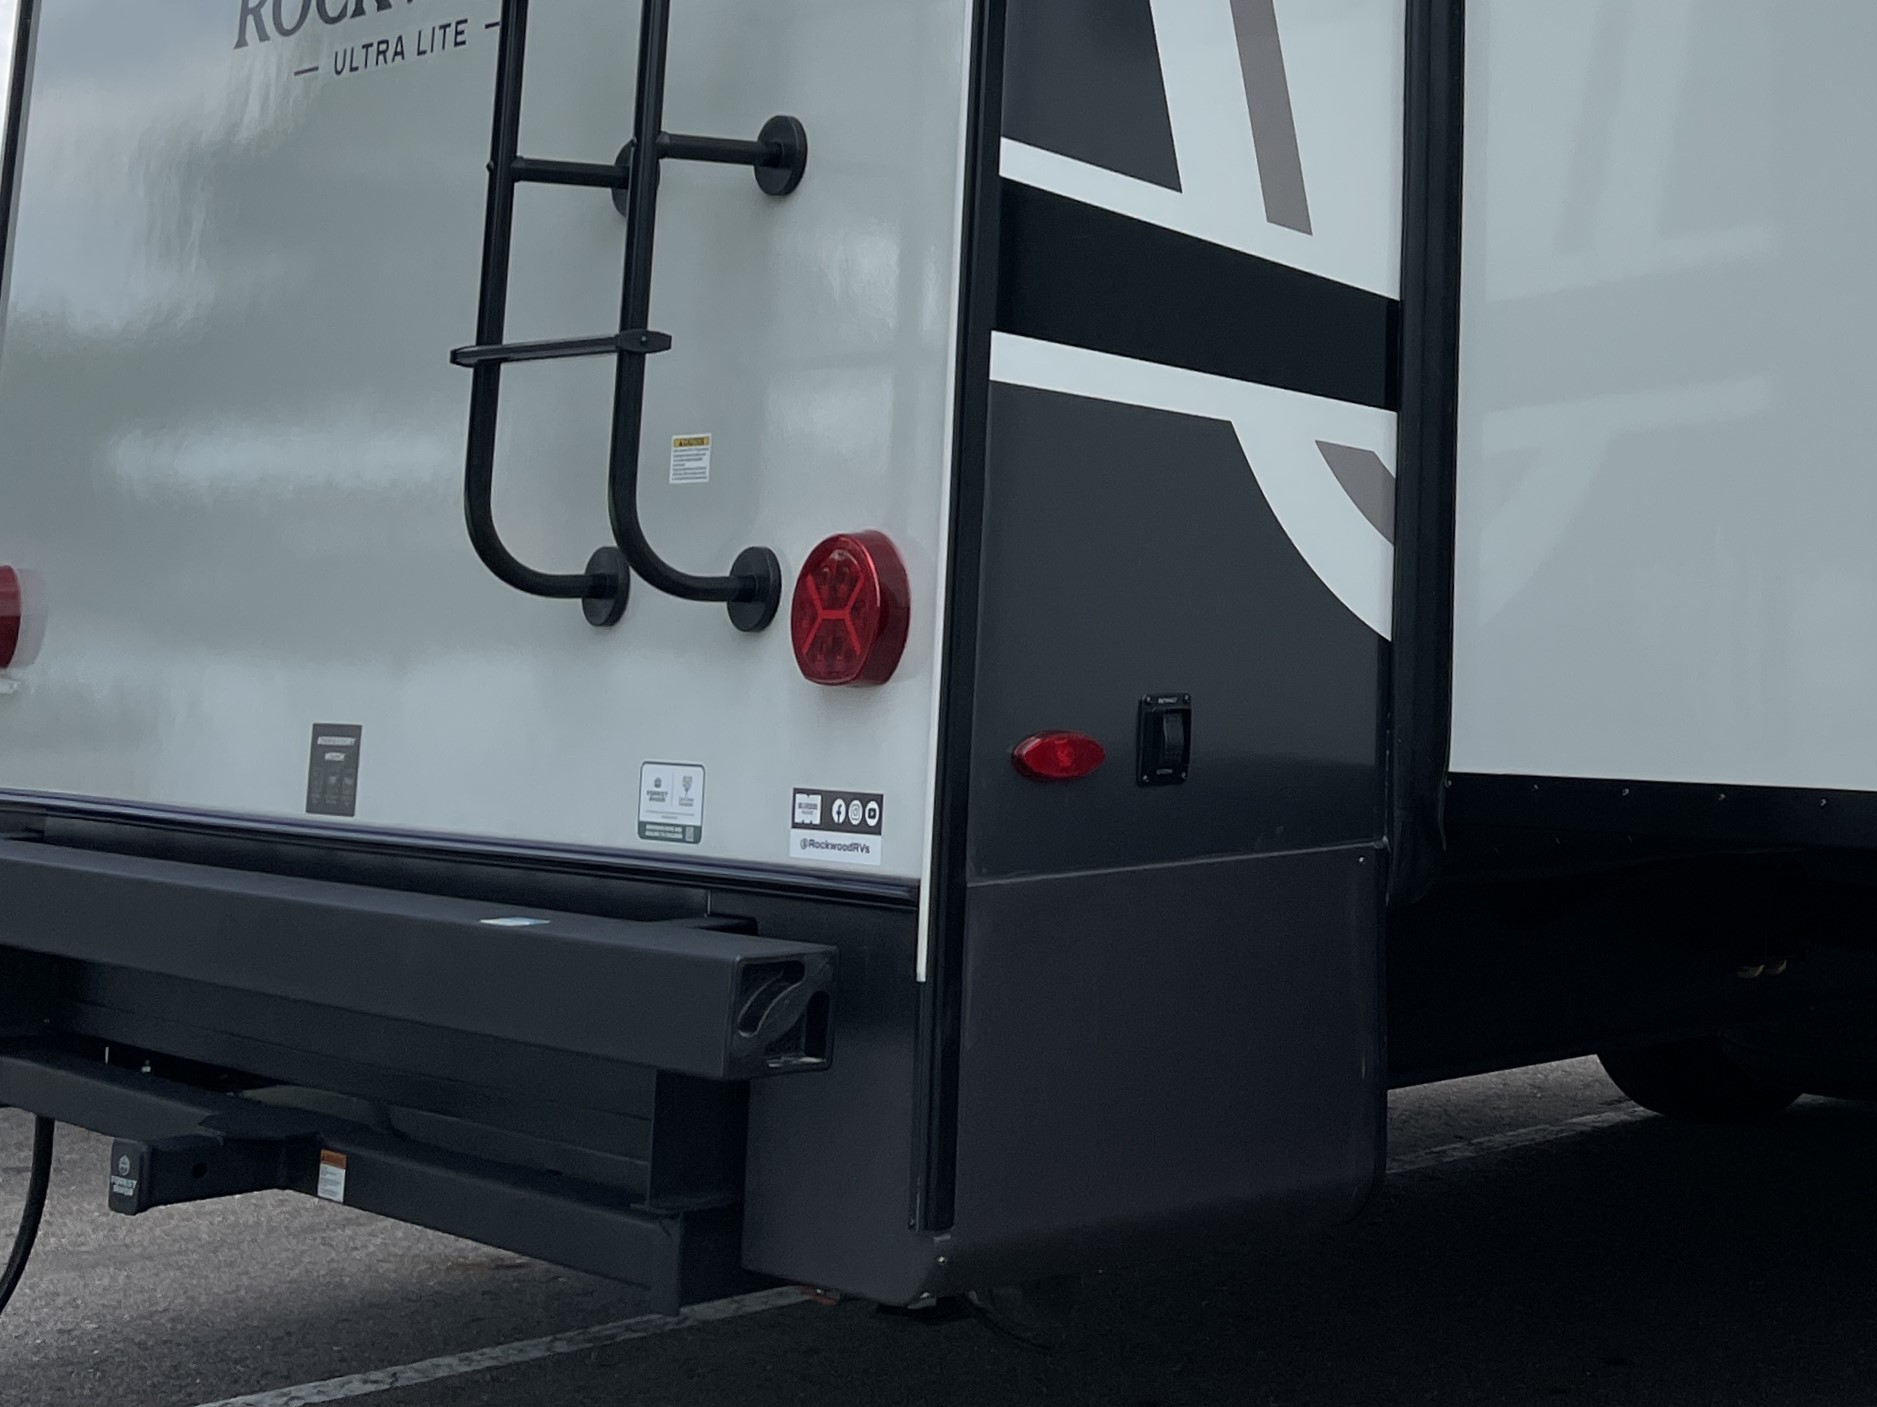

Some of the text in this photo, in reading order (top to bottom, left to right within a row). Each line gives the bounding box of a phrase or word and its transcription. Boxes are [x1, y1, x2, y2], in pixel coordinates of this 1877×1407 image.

[334, 19, 468, 75] ULTRA LITE
[800, 838, 870, 854] @RockwoodRVs
